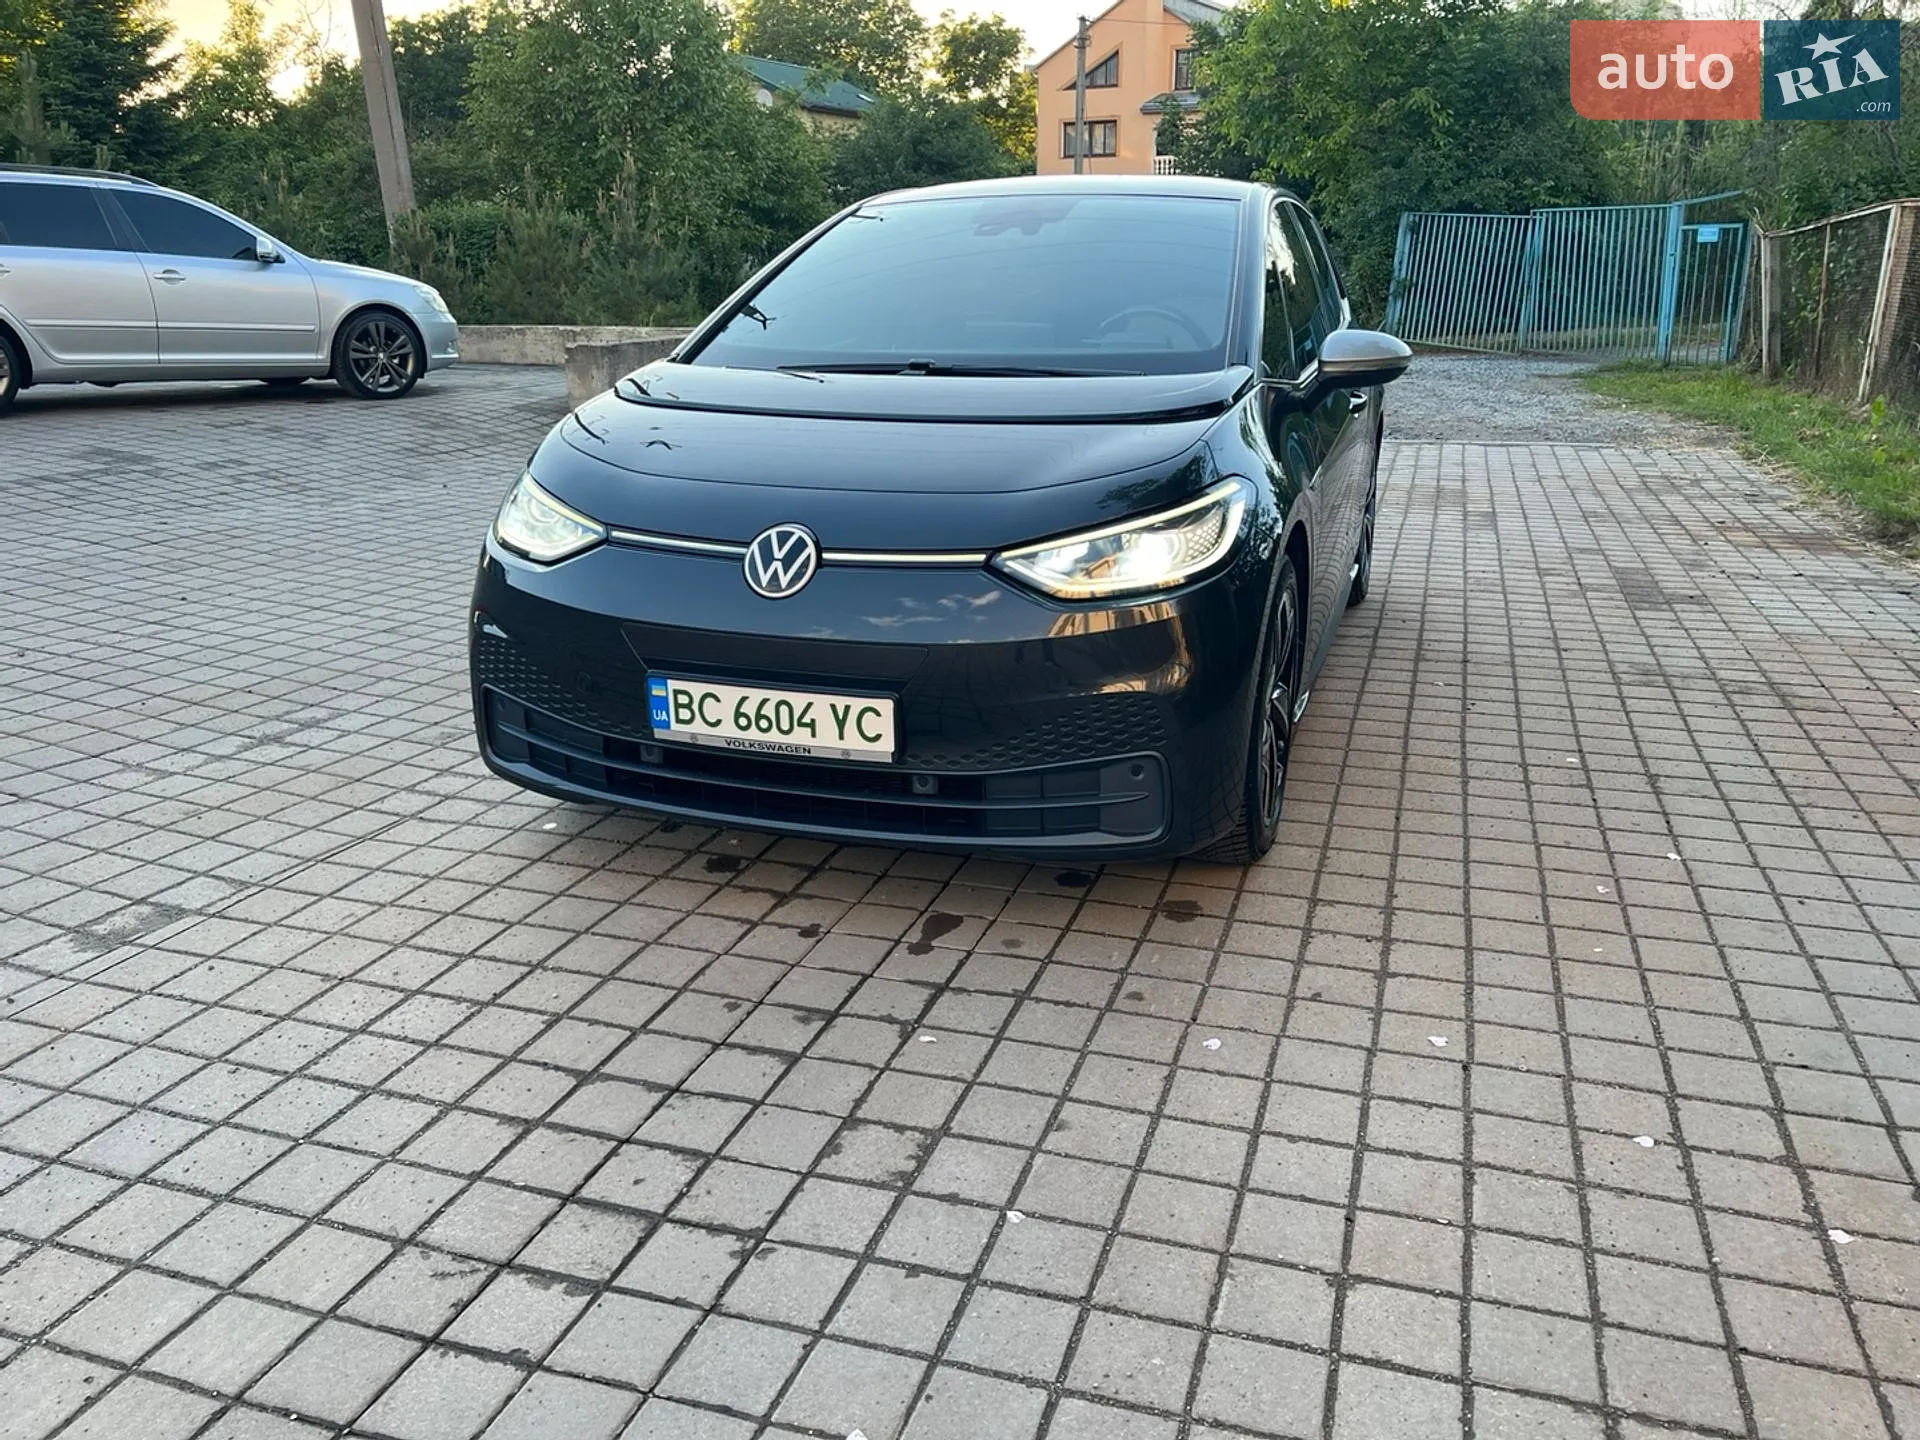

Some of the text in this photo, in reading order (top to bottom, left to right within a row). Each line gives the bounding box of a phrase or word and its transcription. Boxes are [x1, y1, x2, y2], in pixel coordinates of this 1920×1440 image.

[653, 709, 668, 721] UA
[672, 689, 722, 728] BC
[733, 696, 817, 739] 6604
[724, 738, 812, 755] VOLKSWAGEN
